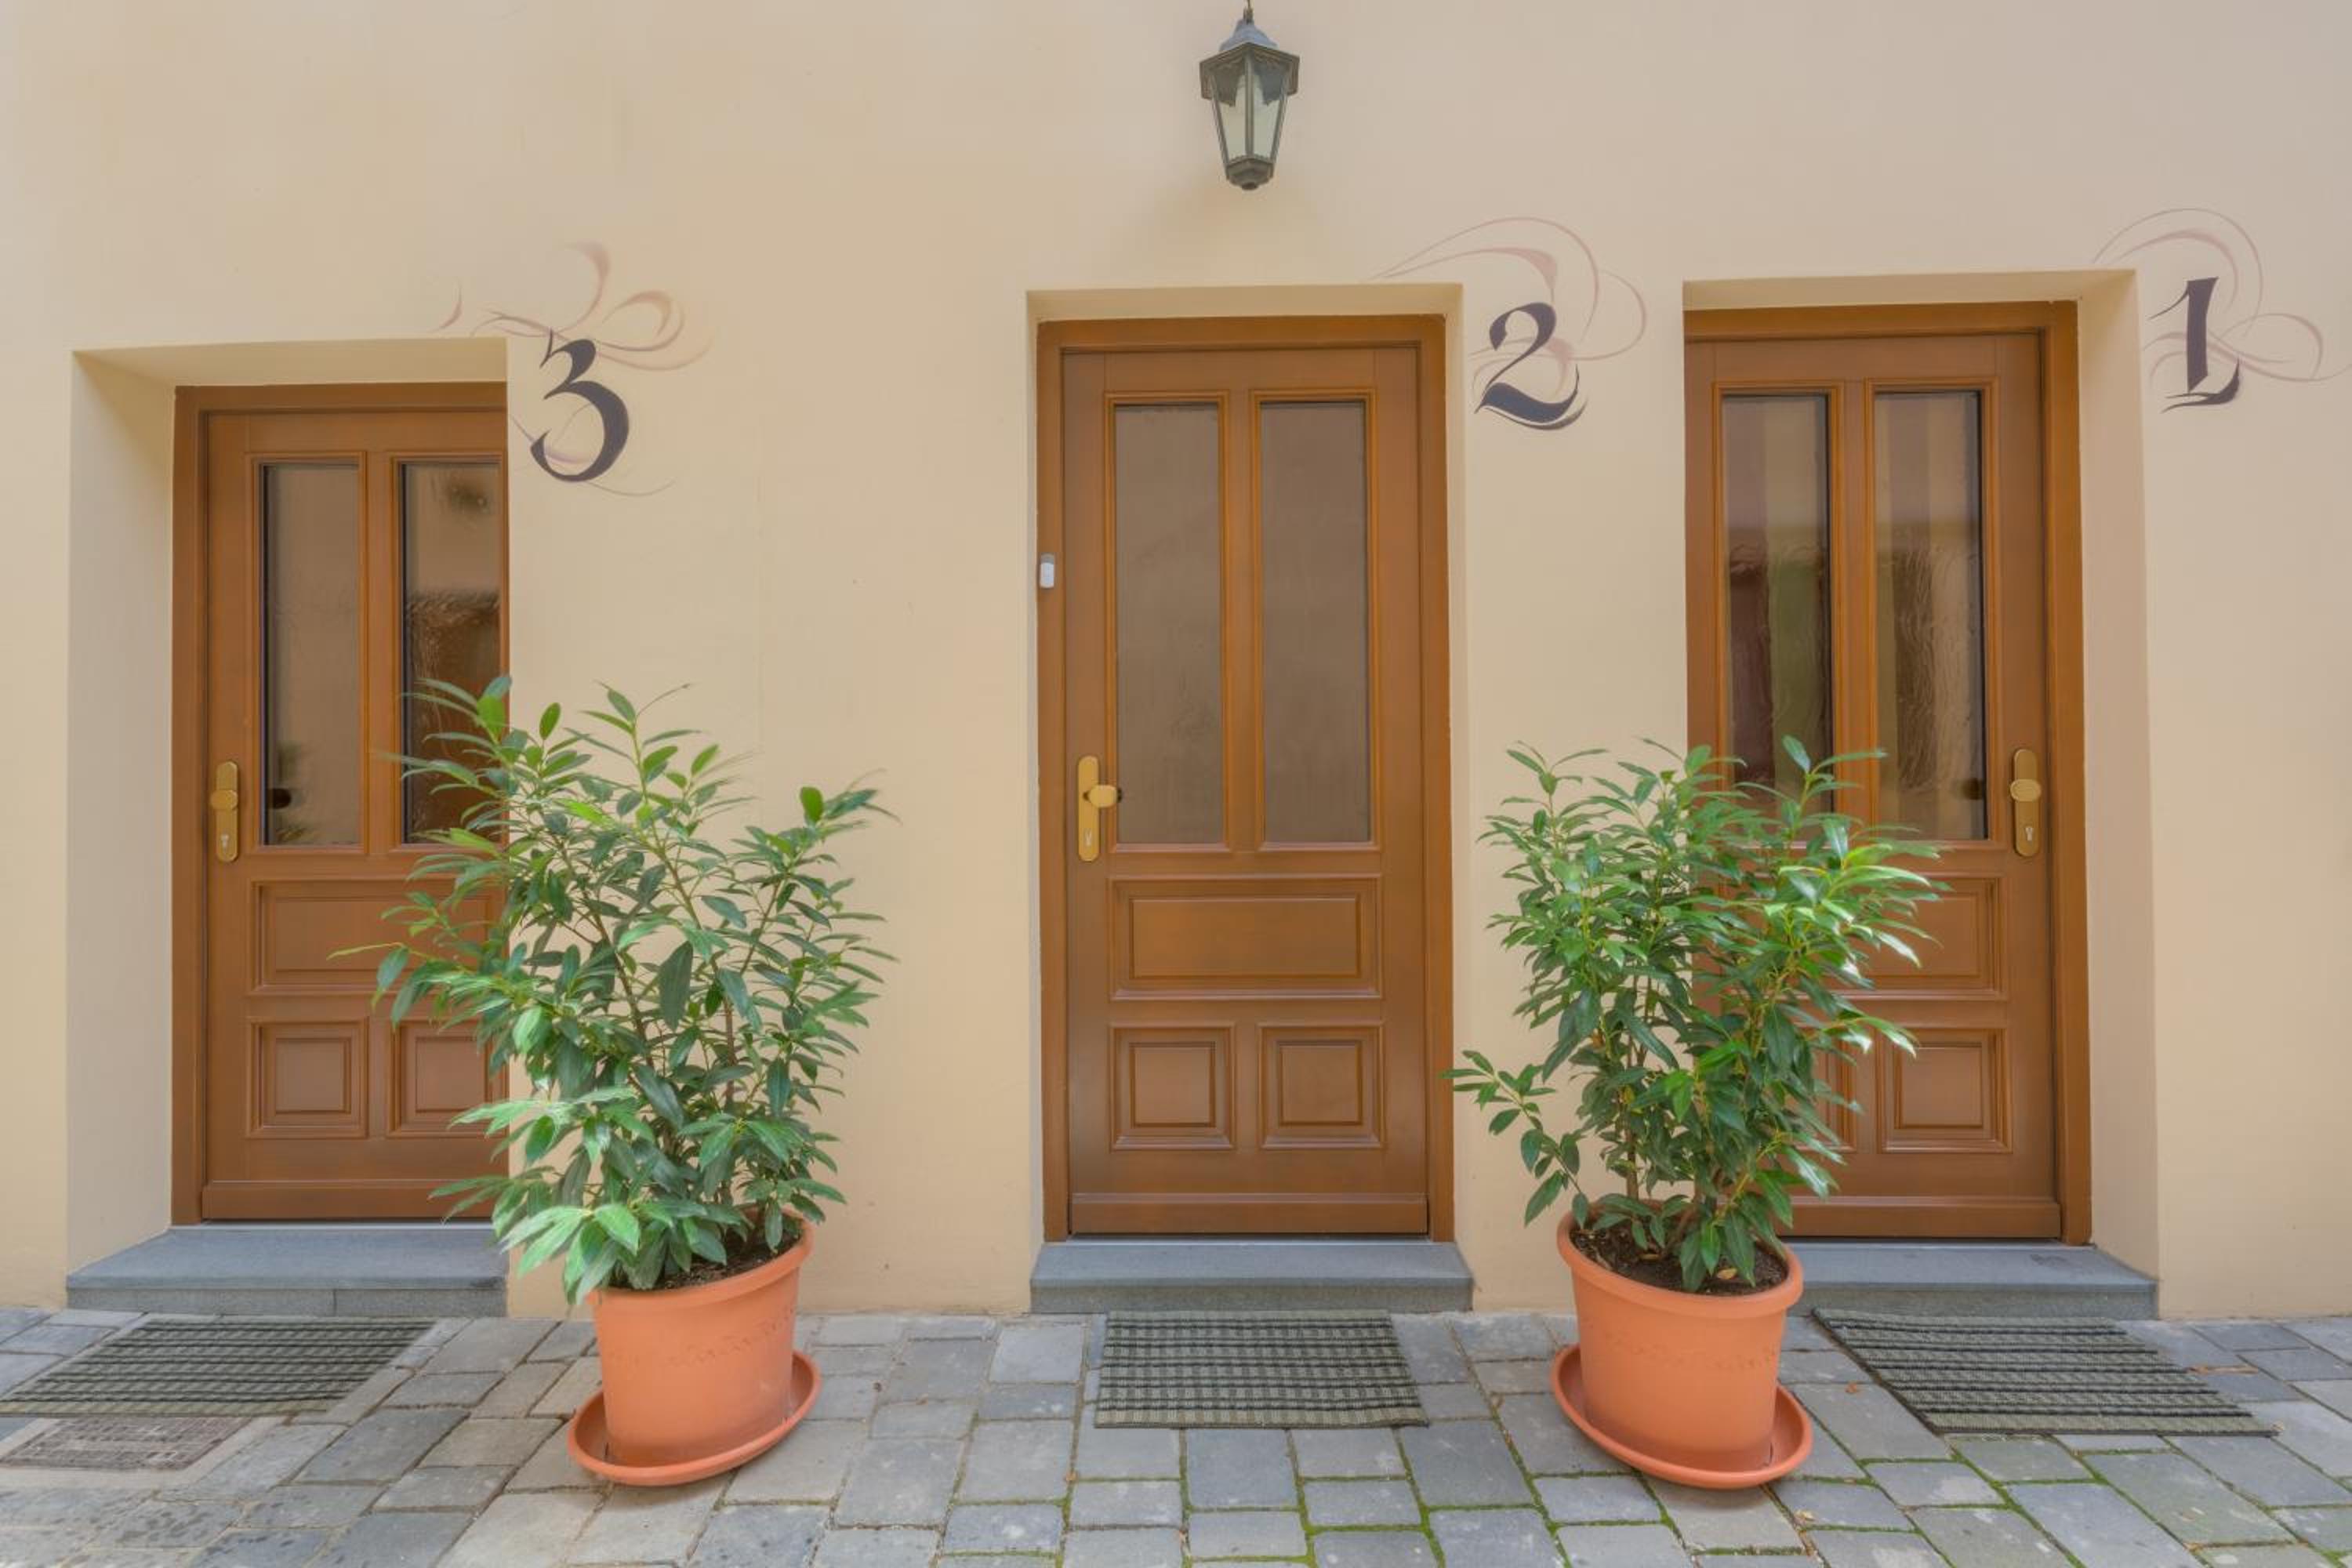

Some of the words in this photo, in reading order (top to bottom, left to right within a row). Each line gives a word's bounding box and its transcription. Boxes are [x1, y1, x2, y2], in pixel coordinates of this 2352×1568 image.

[531, 329, 630, 483] 3
[1475, 302, 1588, 430] 2
[2147, 276, 2240, 414] 1
